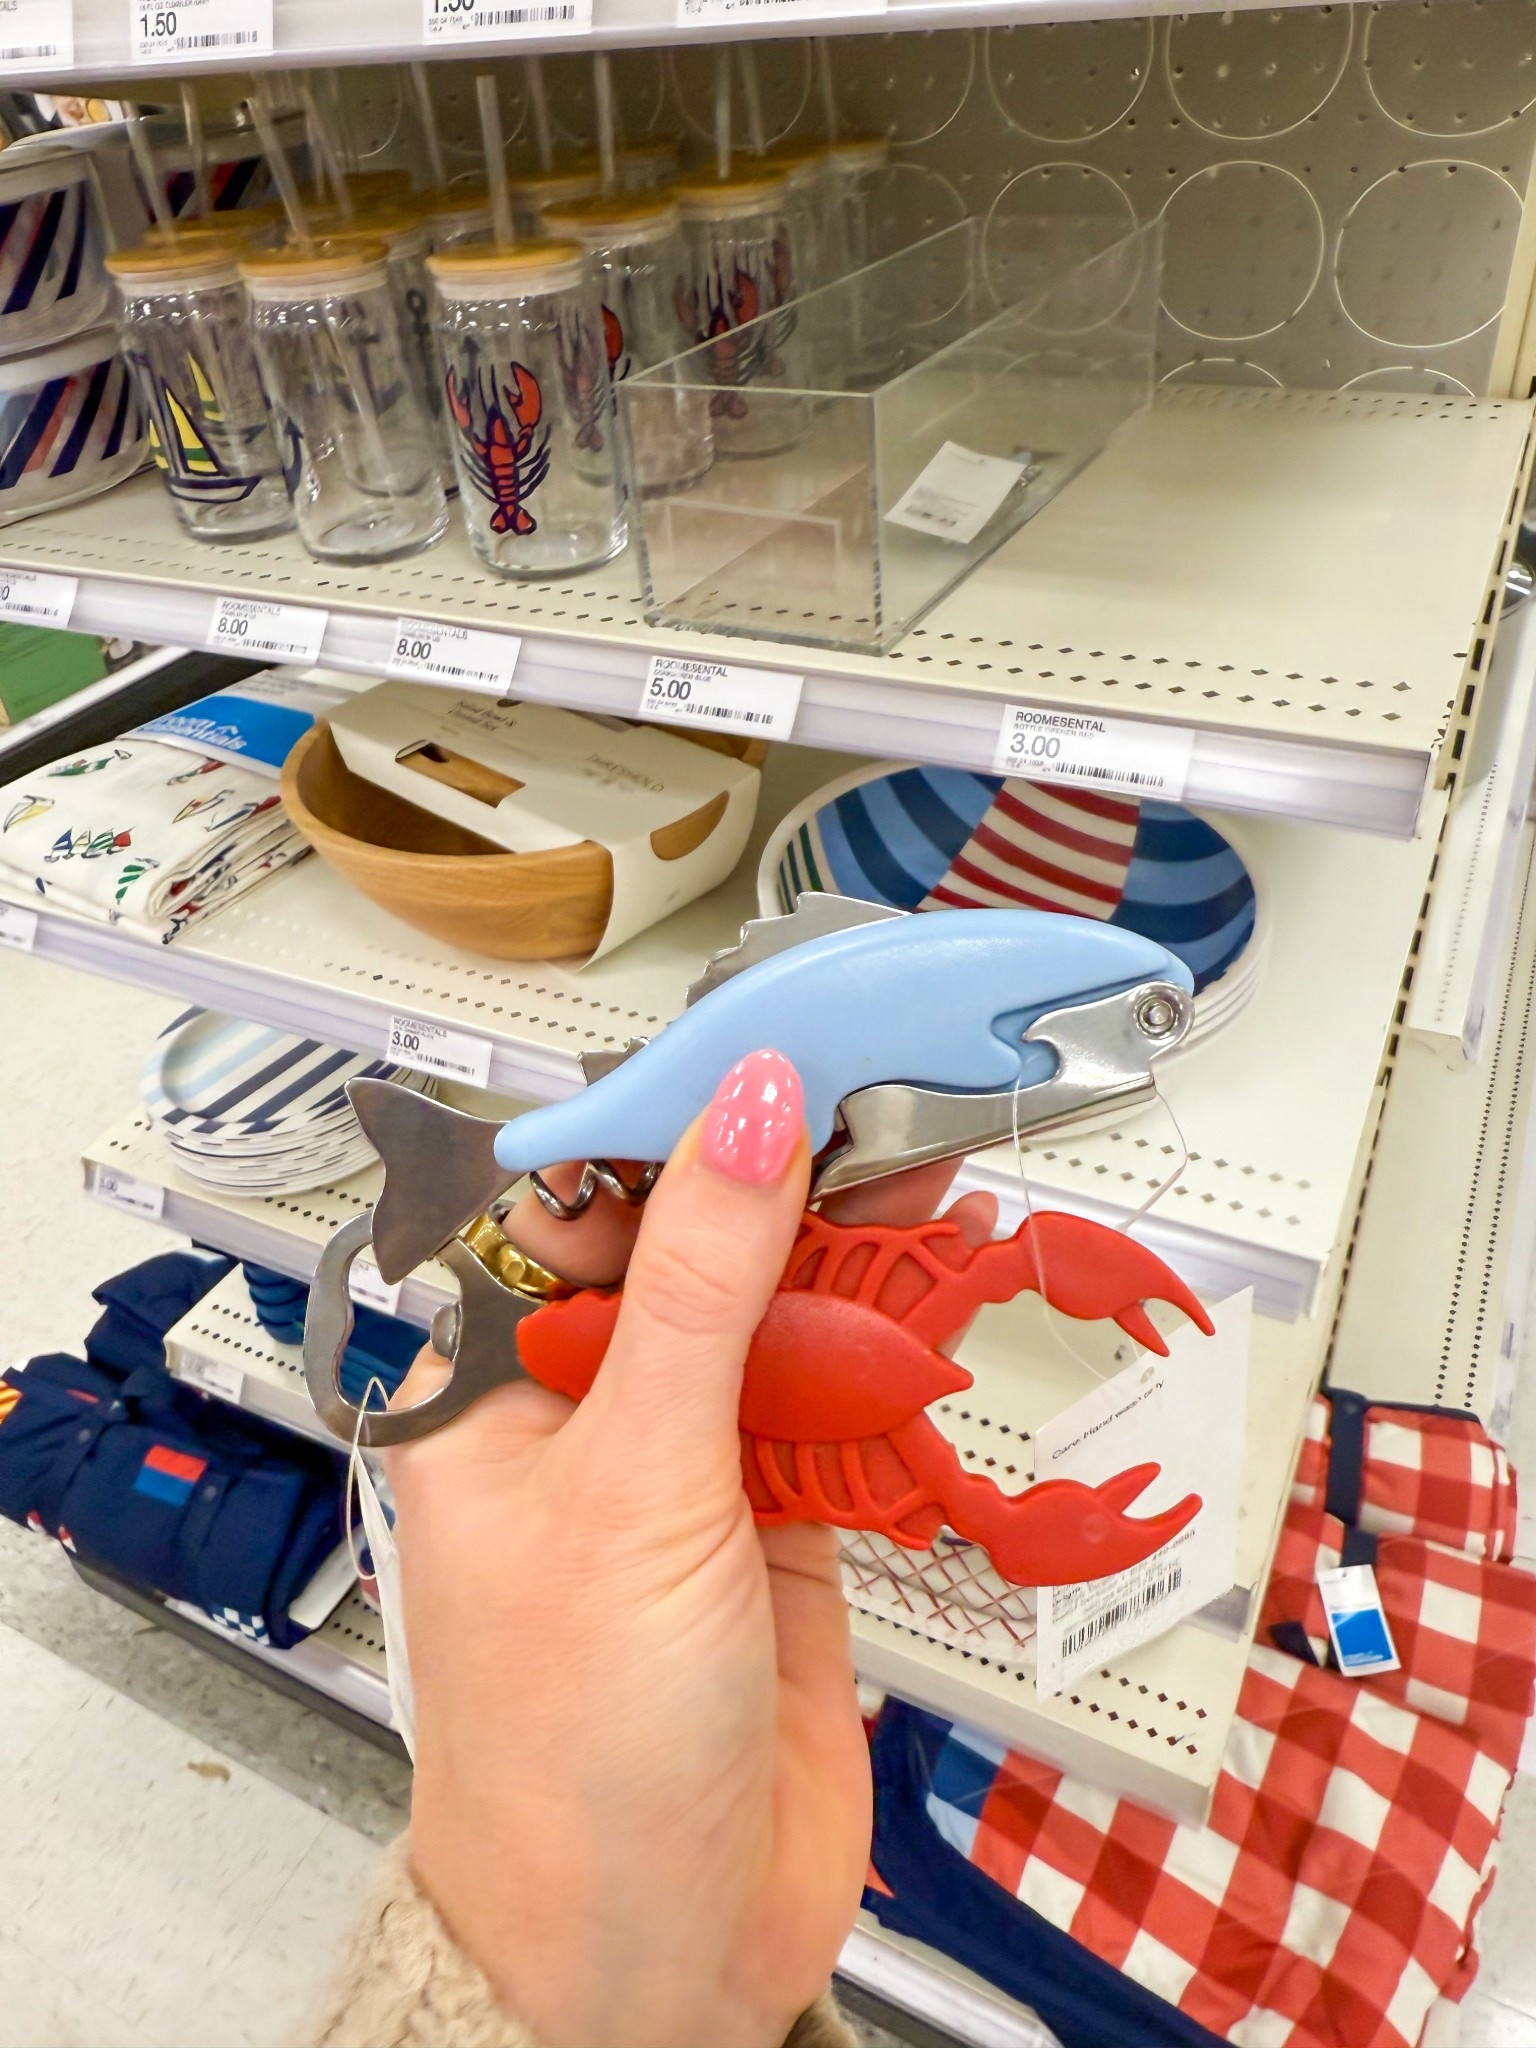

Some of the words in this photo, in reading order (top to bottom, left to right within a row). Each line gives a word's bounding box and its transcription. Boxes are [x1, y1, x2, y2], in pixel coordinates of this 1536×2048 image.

[140, 12, 177, 37] 1.50
[217, 616, 249, 637] 8.00
[397, 638, 432, 660] 8.00
[650, 677, 692, 700] 5.00
[1015, 711, 1106, 733] ROOMESENTAL
[1010, 732, 1061, 758] 3.00
[392, 1031, 420, 1051] 3.00
[1083, 1414, 1113, 1439] Hand
